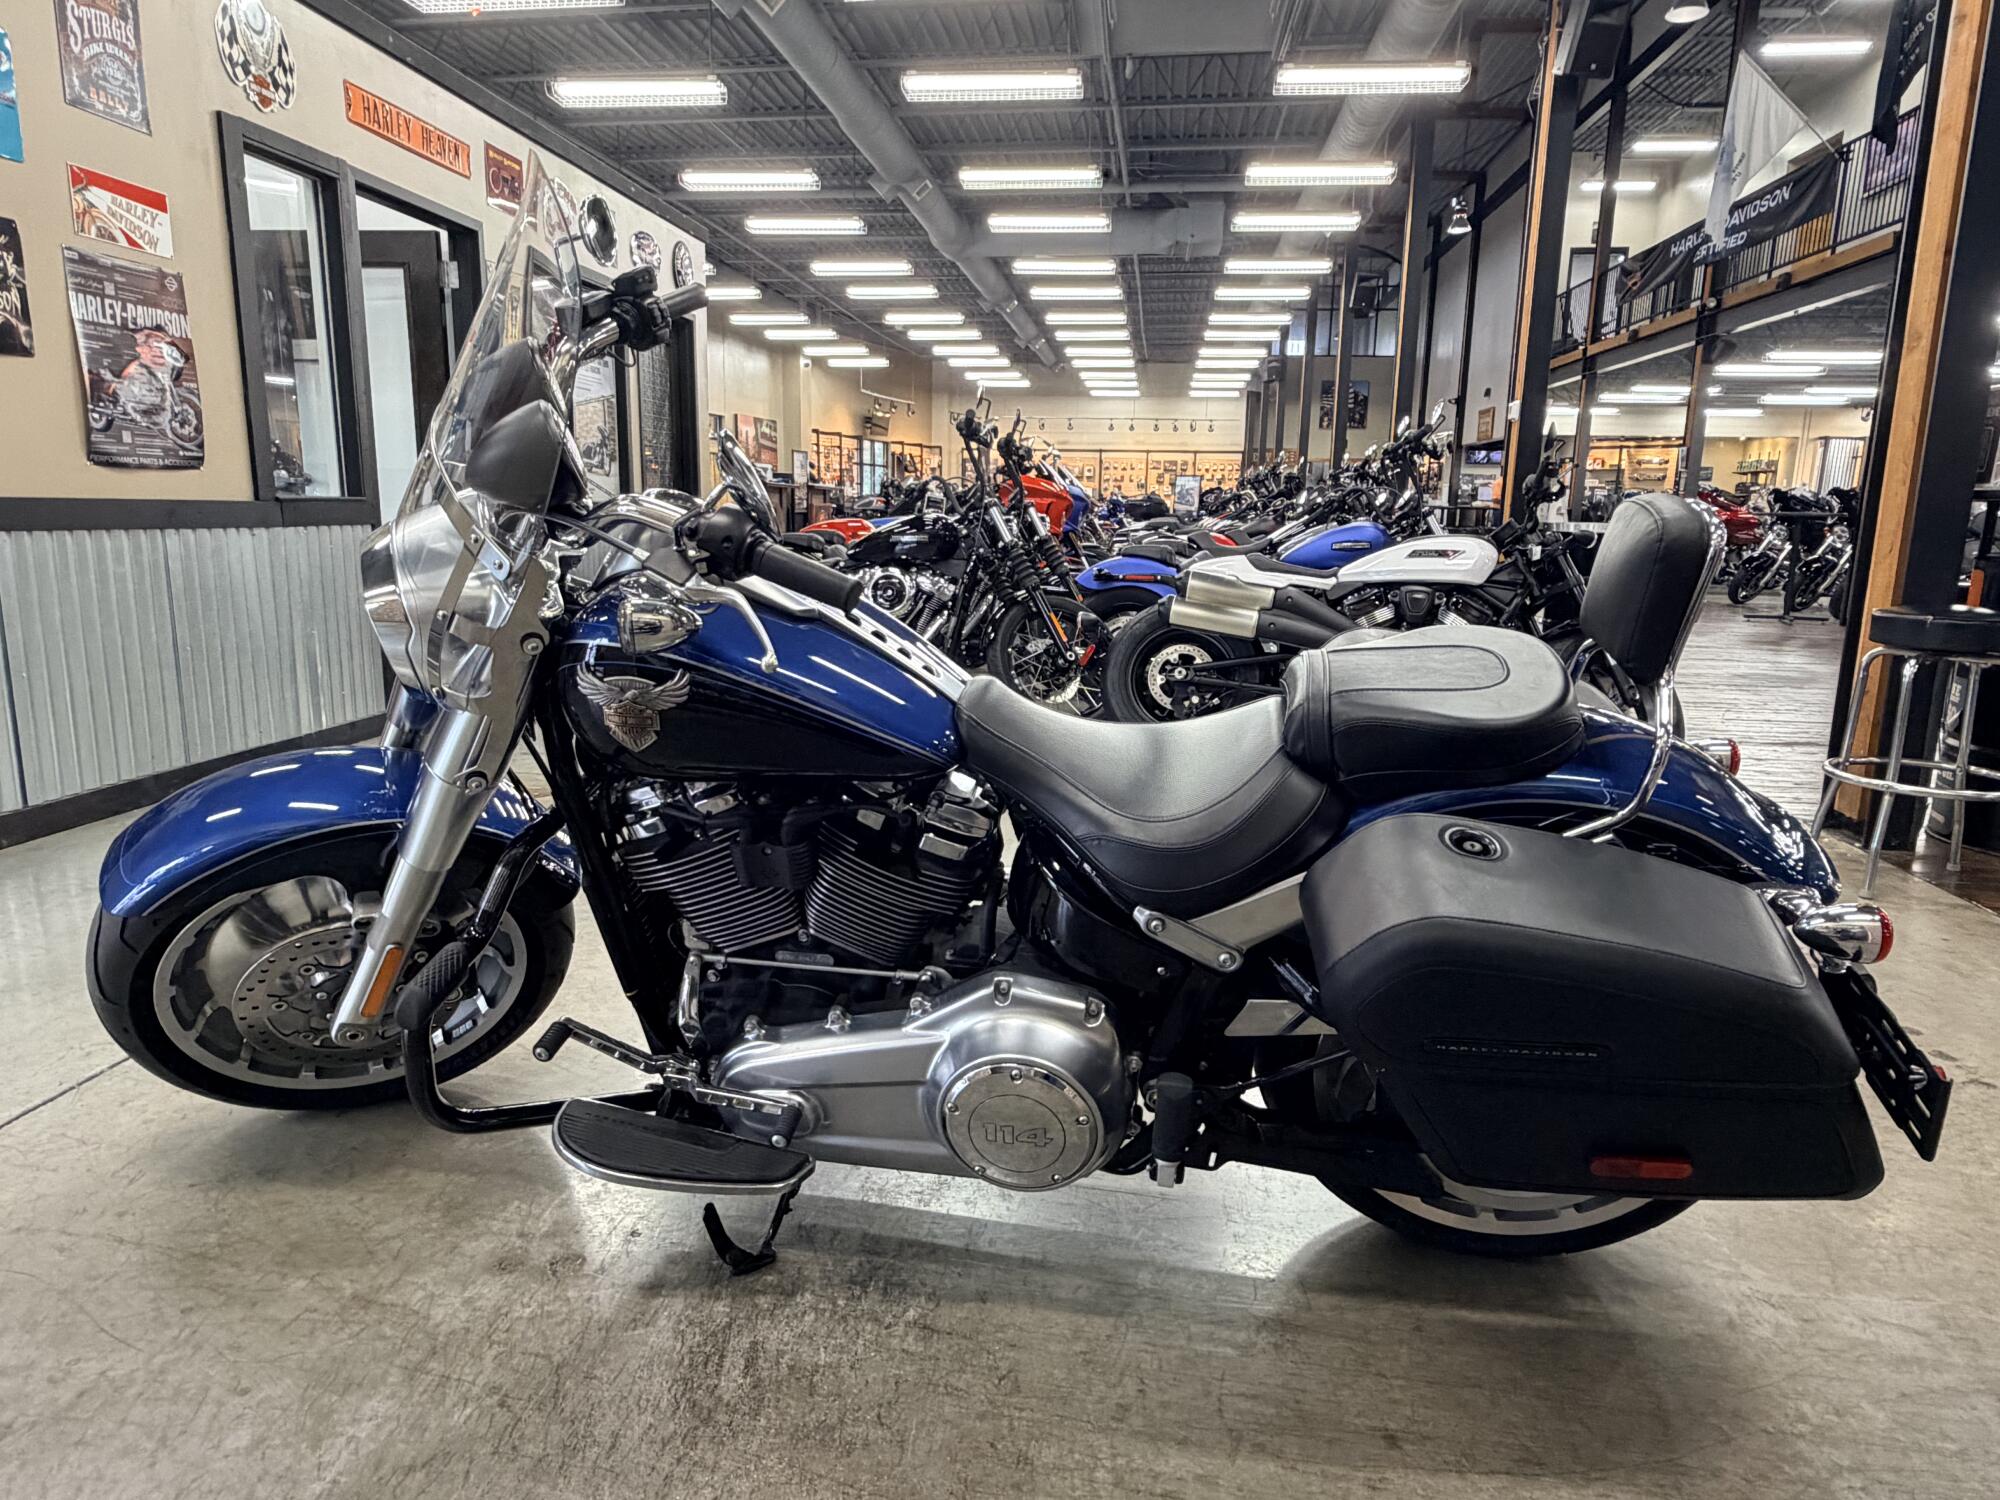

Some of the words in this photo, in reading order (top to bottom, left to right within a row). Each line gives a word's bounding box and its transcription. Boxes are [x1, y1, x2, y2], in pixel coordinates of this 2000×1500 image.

[66, 1, 136, 55] STURGIS
[362, 94, 411, 143] HARLEY
[421, 124, 461, 169] HEAVEN
[107, 204, 159, 252] DAVIDSON
[111, 194, 162, 229] HARLEY-
[69, 290, 191, 339] HARLEY-DAVIDSON
[983, 1122, 1053, 1147] 114
